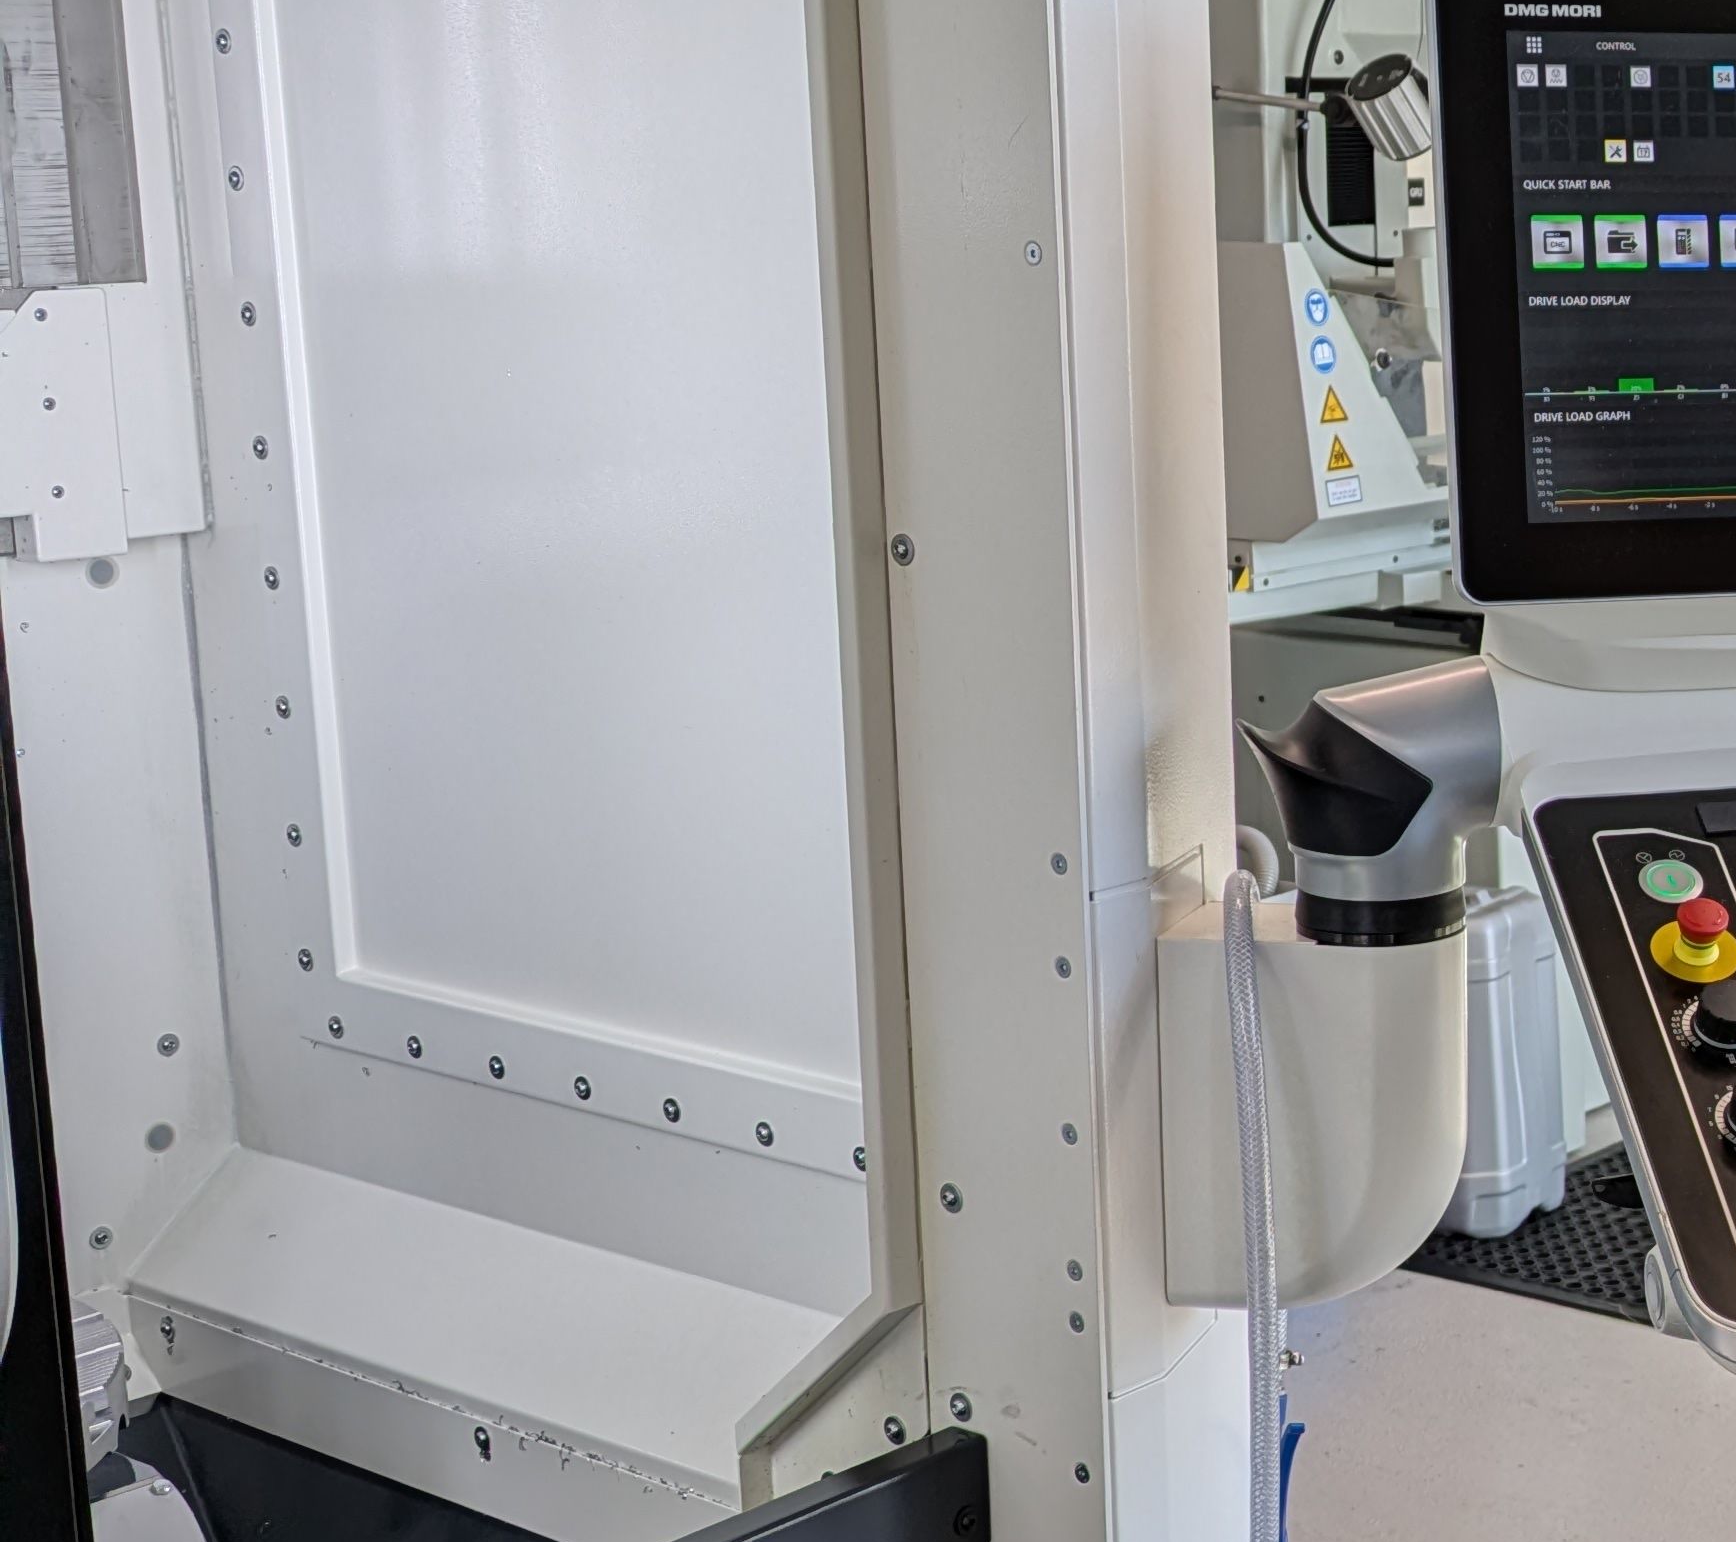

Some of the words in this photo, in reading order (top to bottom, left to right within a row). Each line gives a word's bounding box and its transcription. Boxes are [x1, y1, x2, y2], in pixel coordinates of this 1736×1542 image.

[1504, 4, 1549, 17] DMG
[1552, 5, 1601, 18] MORI
[1596, 42, 1637, 51] CONTROL
[1716, 72, 1730, 84] 54
[1523, 179, 1556, 190] QUICK
[1558, 179, 1588, 190] START
[1590, 179, 1611, 190] BAR
[1528, 296, 1558, 307] DRIVE
[1560, 296, 1588, 306] LOAD
[1590, 295, 1631, 306] DISPLAY
[1534, 412, 1563, 423] DRIVE
[1565, 412, 1593, 422] LOAD
[1596, 411, 1630, 422] GRAPH
